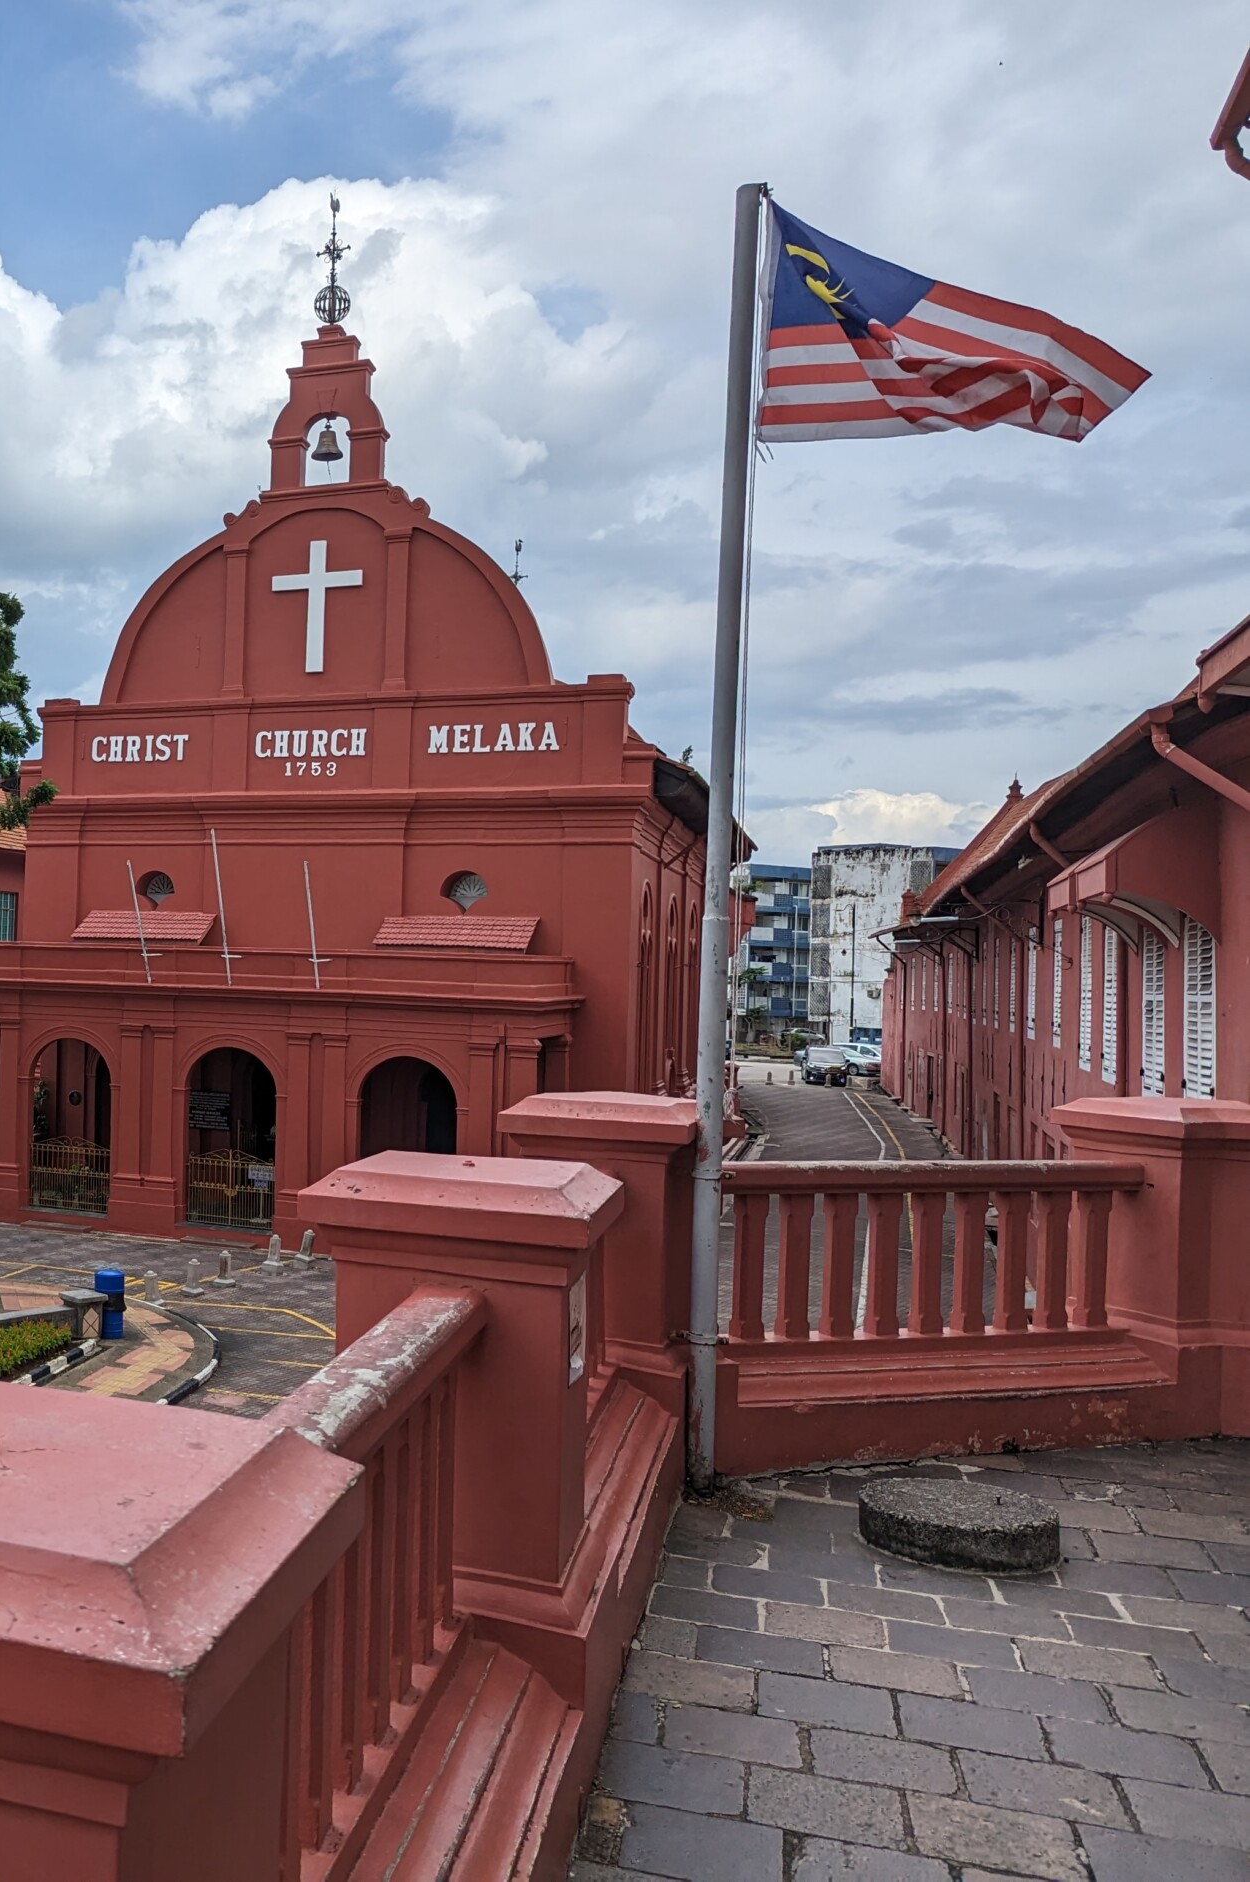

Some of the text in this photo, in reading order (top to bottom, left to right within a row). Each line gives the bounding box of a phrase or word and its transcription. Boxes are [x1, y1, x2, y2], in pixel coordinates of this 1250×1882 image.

[91, 721, 560, 762] CHRIST CHURCH MELAKA
[284, 761, 337, 777] 1753
